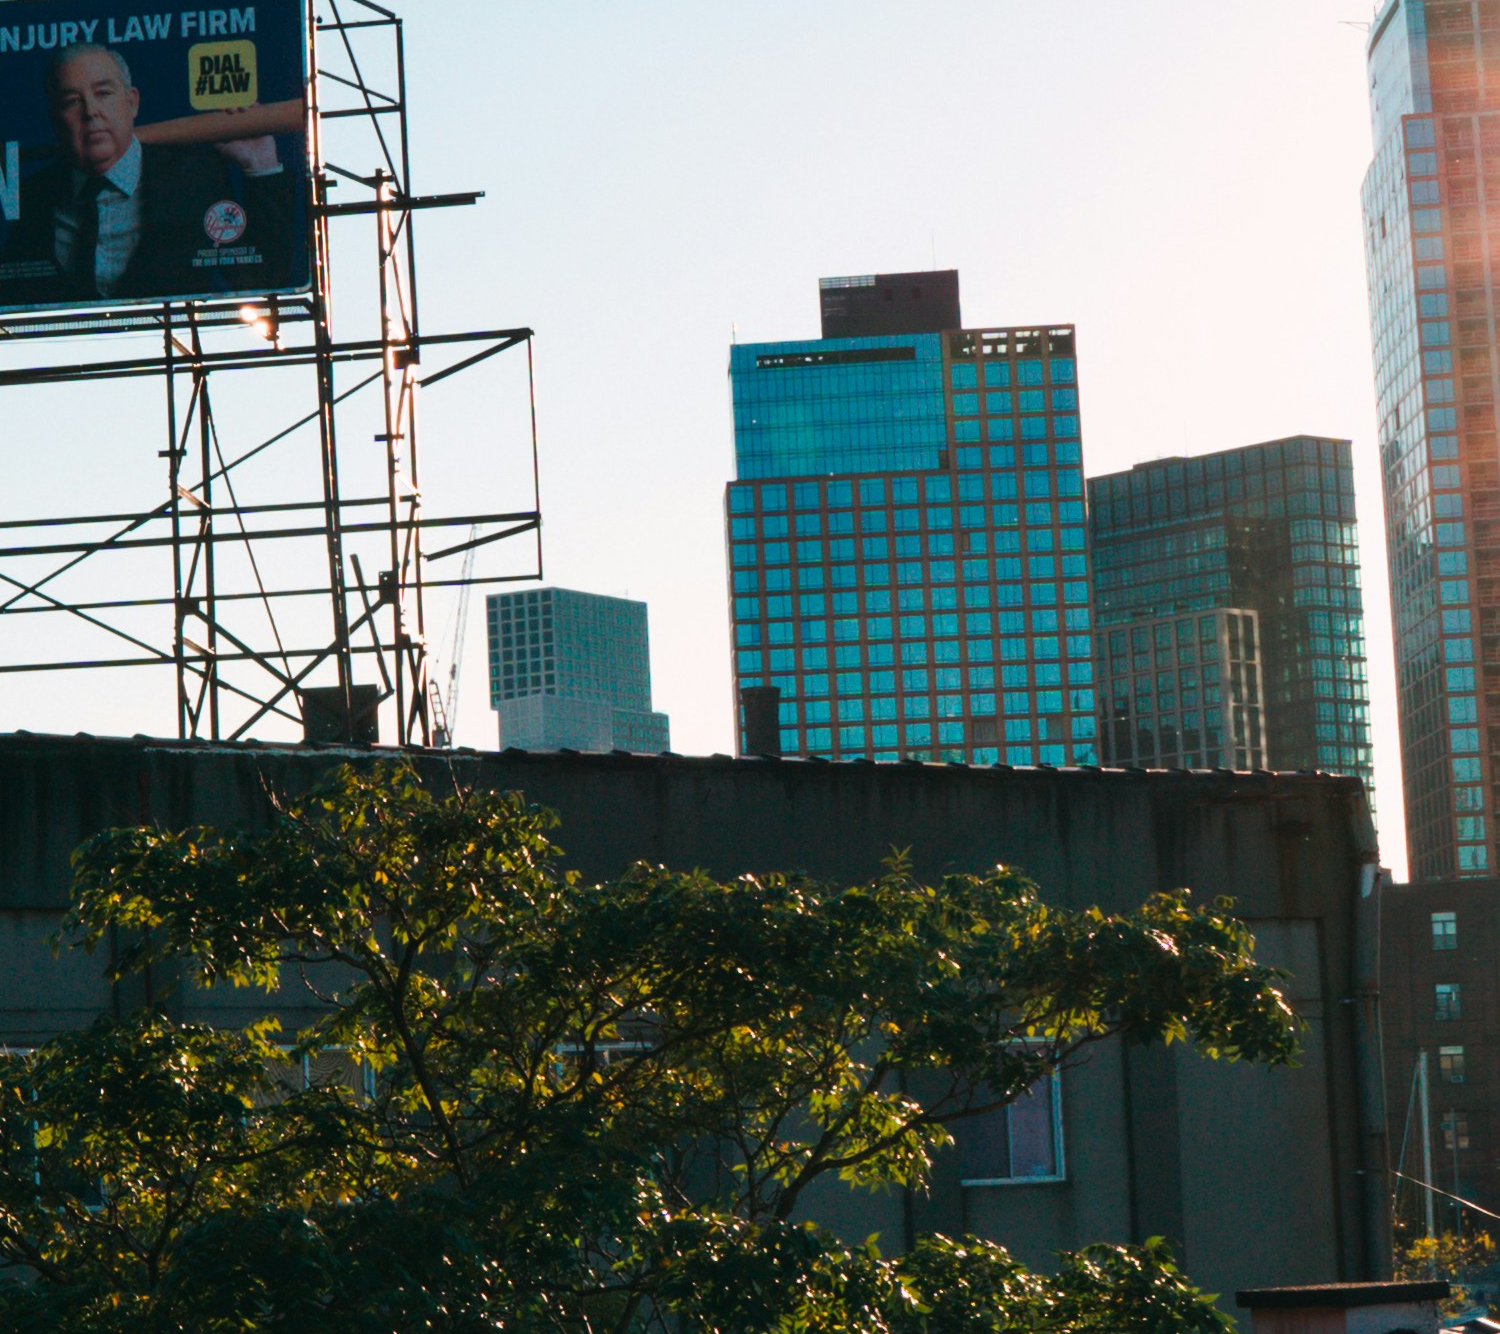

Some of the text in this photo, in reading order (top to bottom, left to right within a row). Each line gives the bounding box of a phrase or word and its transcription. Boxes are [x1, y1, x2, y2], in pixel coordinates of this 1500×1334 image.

[107, 13, 172, 44] LAW
[180, 7, 256, 38] FIRM
[200, 53, 245, 75] DIAL
[195, 72, 250, 96] #LAW
